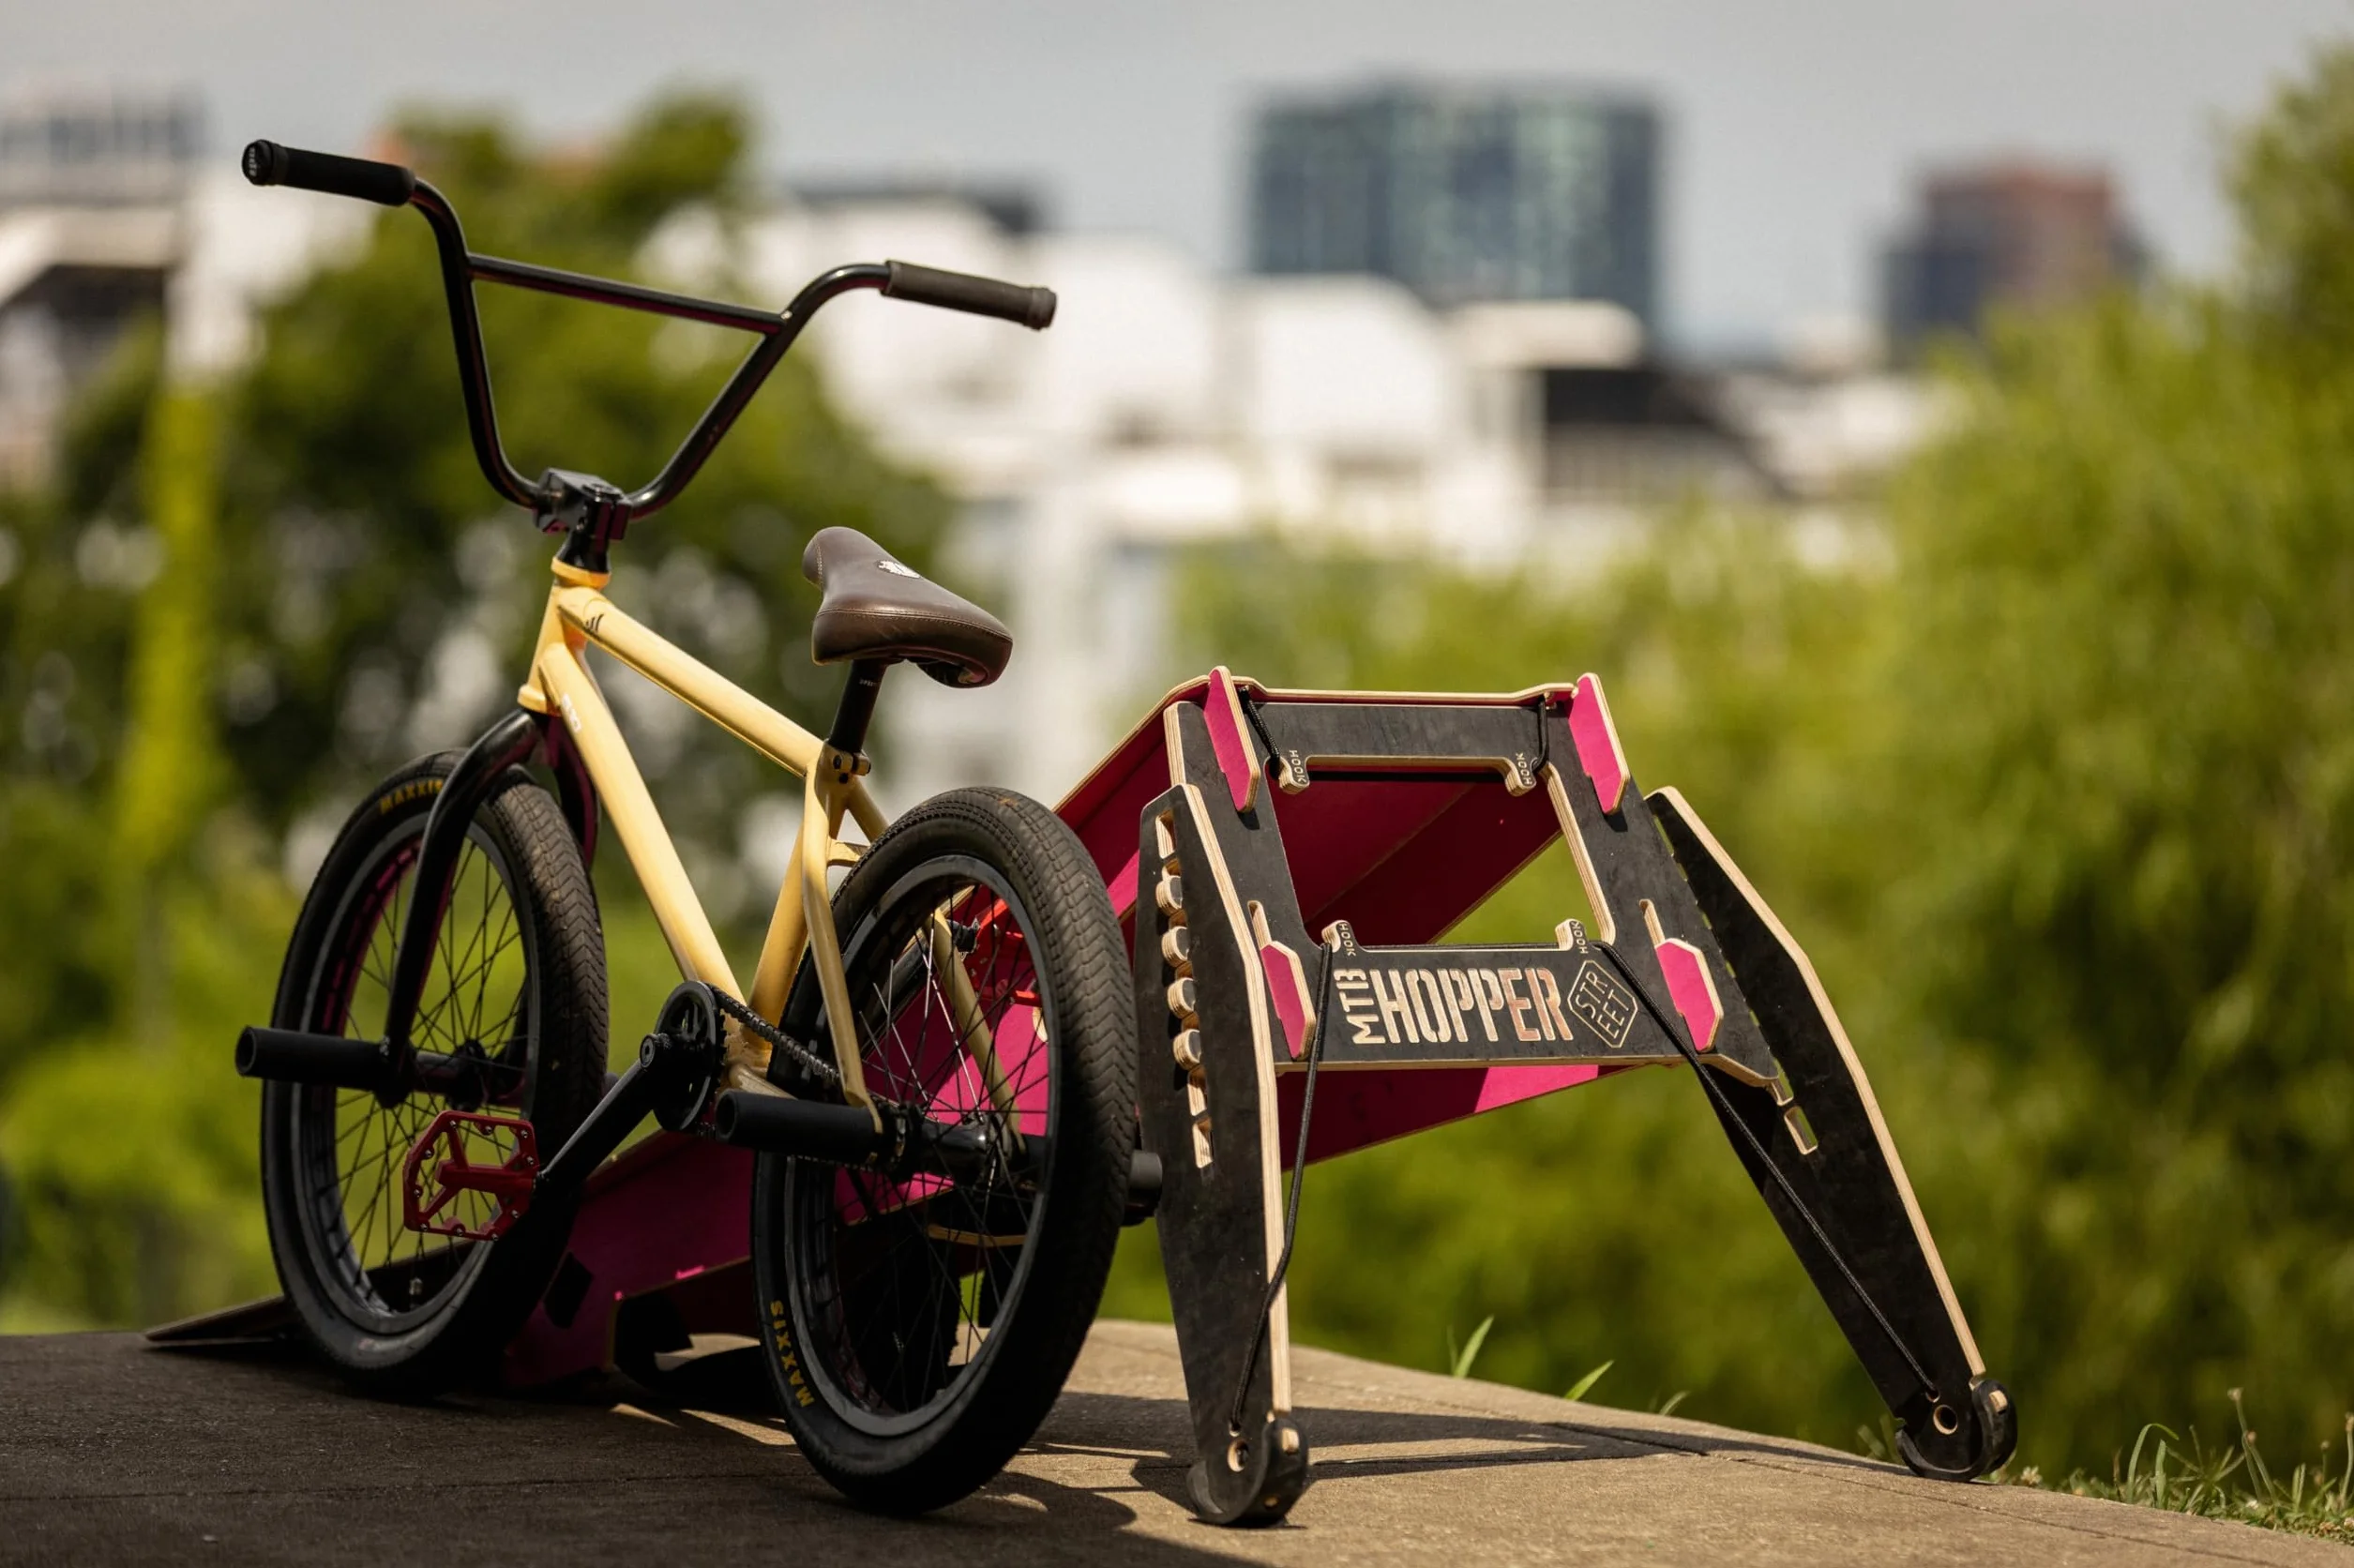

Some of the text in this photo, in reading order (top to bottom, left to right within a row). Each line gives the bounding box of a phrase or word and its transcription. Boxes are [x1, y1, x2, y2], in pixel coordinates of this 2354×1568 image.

[1289, 749, 1307, 784] HOOK
[1515, 752, 1533, 785] HOOK
[1338, 923, 1357, 957] HOOK
[1571, 921, 1589, 955] HOOK
[1334, 968, 1574, 1045] MTB HOPPER
[770, 1300, 815, 1408] MAXXIS
